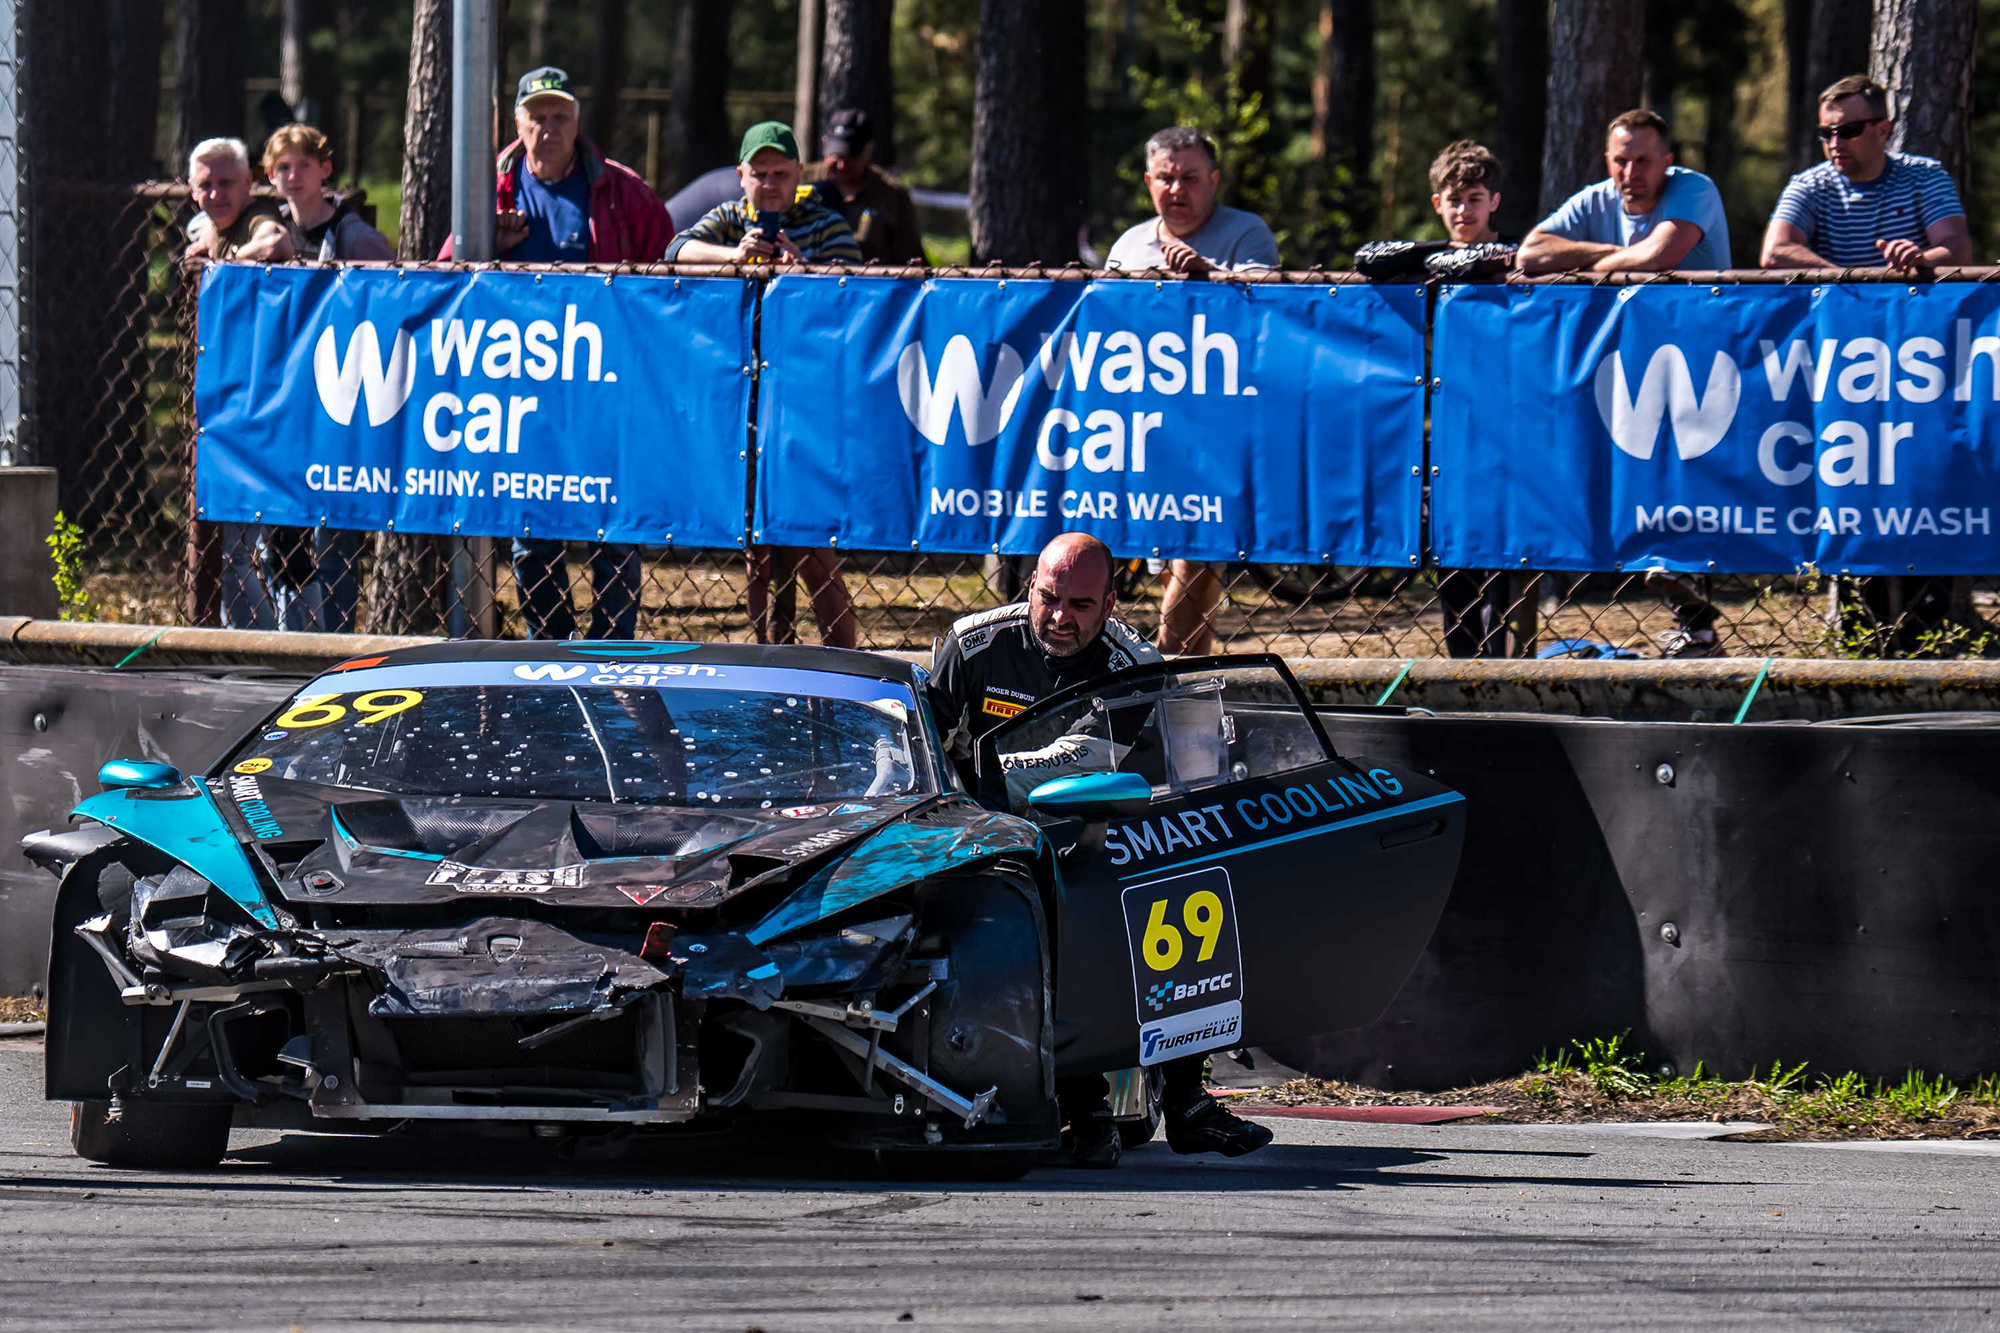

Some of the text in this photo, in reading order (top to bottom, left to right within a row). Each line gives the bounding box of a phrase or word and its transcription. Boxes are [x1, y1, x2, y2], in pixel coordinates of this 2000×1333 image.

[431, 304, 617, 383] wash.
[1039, 313, 1259, 396] wash.
[423, 392, 538, 454] car
[1036, 407, 1163, 473] car
[1757, 420, 1914, 487] car
[306, 463, 618, 504] CLEAN. SHINY. PERFECT.
[930, 487, 1223, 523] MOBILE CAR WASH
[1635, 504, 1990, 536] MOBILE CAR WASH
[963, 632, 987, 648] OMP
[590, 673, 669, 686] car
[596, 663, 726, 678] wash.
[276, 689, 424, 728] 69
[985, 685, 1036, 702] ROGER DUBUIS
[1002, 756, 1046, 770] OGER
[229, 775, 283, 839] SMART COOLING
[1104, 767, 1404, 866] SMART COOLING
[1142, 890, 1224, 971] 69
[1173, 972, 1233, 1001] BaTCC
[1158, 1021, 1238, 1051] TURATELLO
